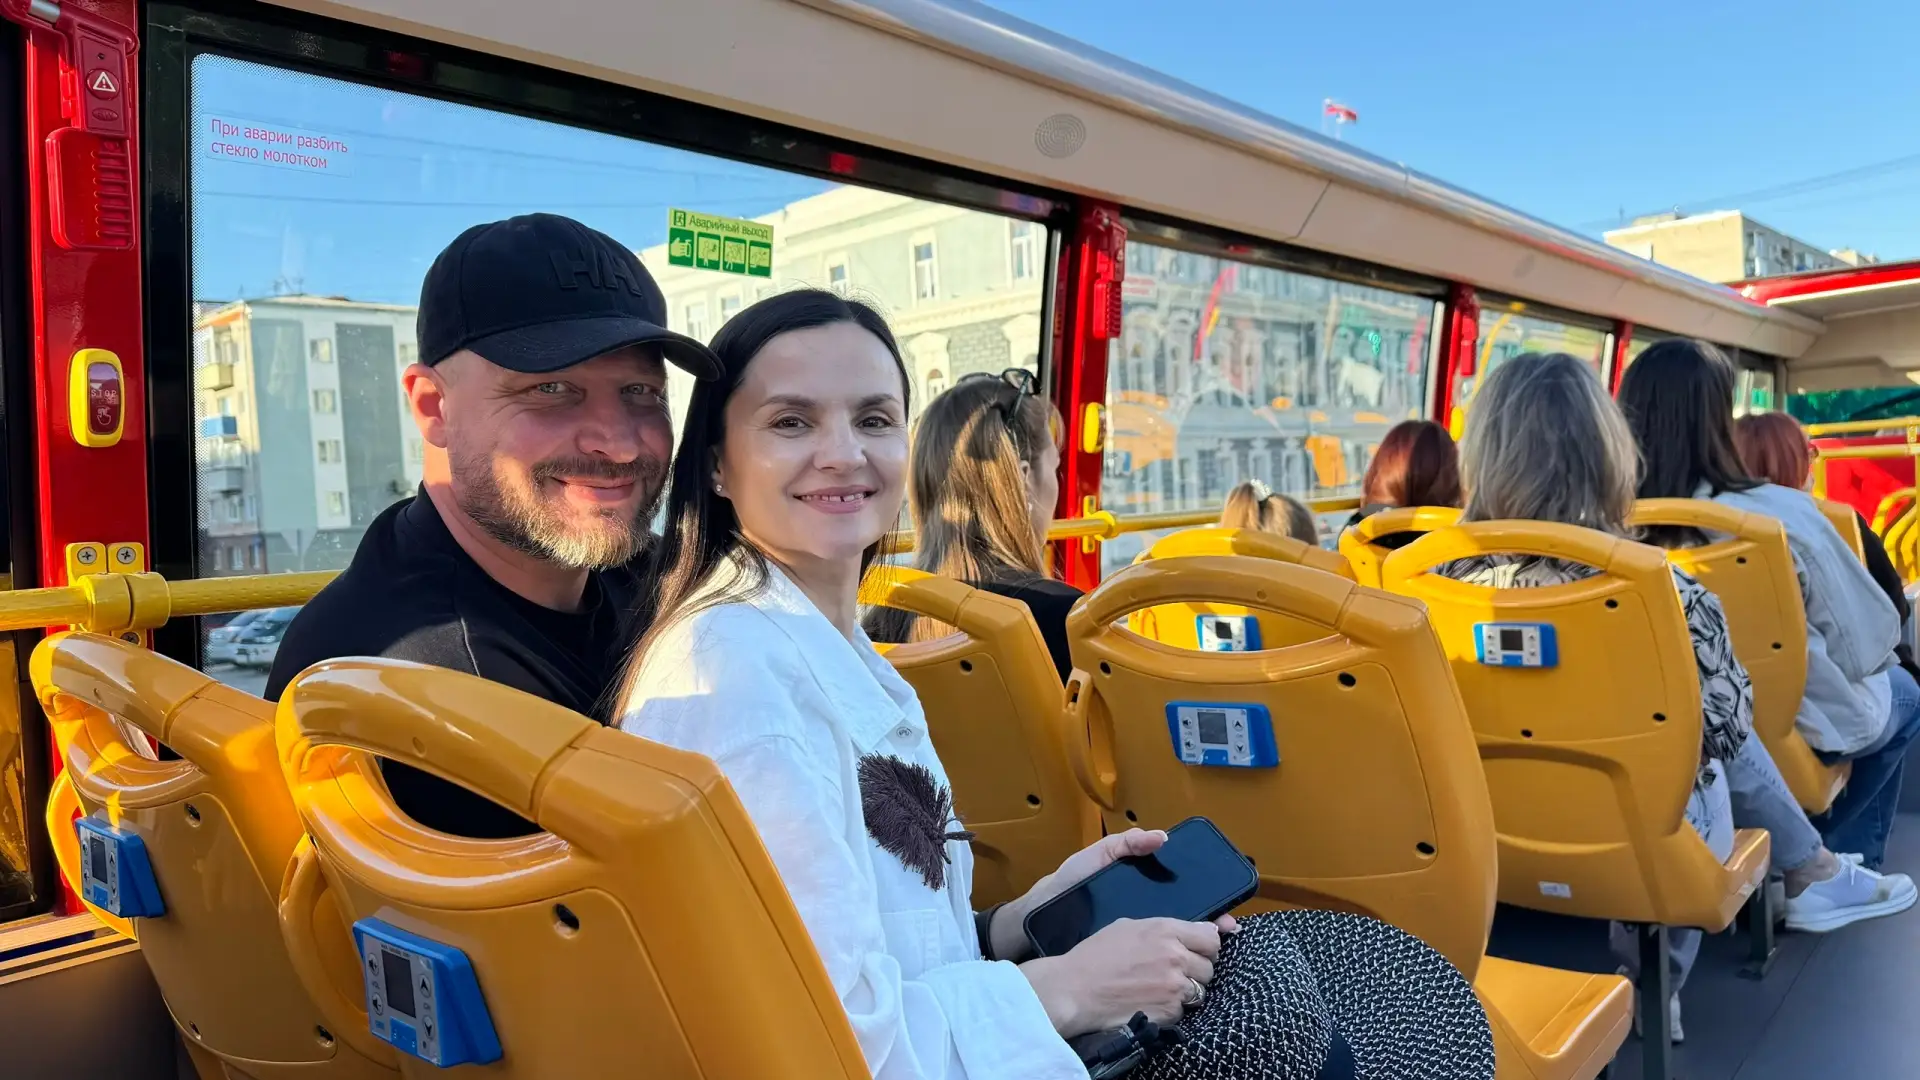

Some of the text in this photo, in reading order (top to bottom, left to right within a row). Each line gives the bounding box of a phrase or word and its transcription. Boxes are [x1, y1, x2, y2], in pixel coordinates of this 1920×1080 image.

[211, 119, 348, 153] При аварии разбить
[211, 142, 327, 168] стекло молотком
[689, 215, 768, 239] Аварийный выход
[91, 389, 117, 398] STOP
